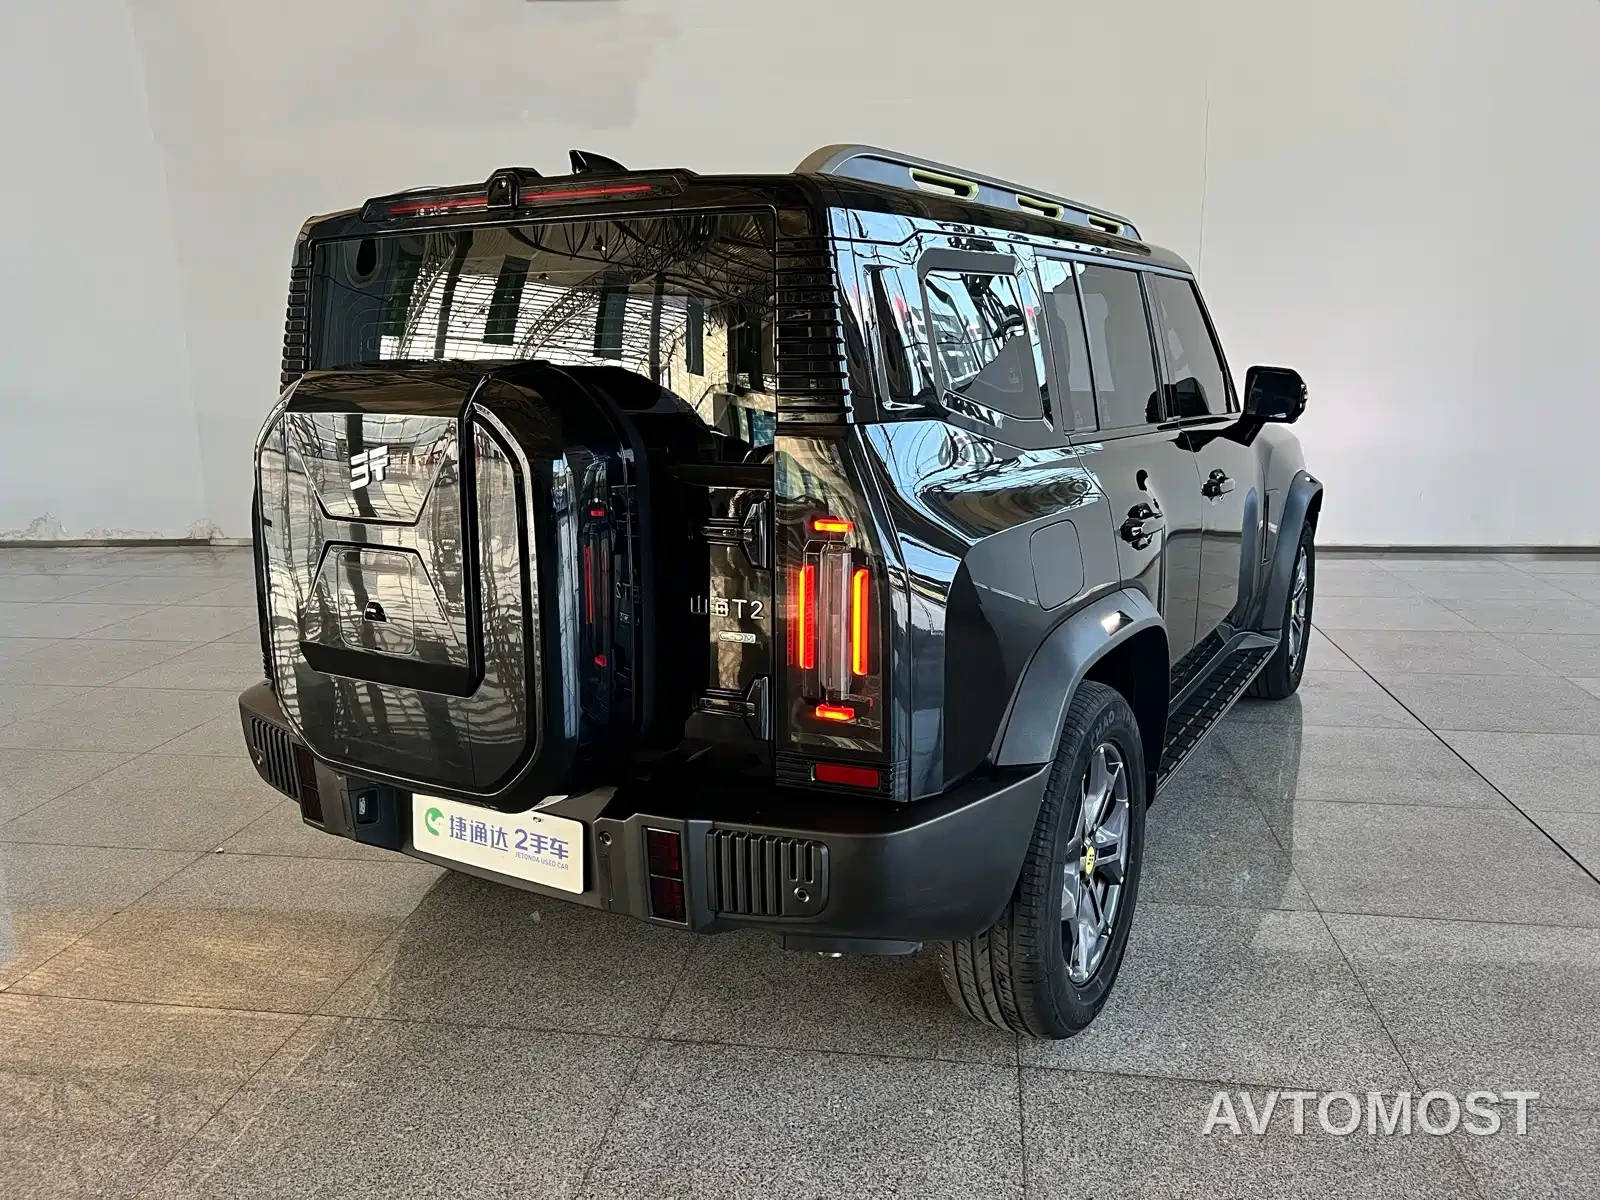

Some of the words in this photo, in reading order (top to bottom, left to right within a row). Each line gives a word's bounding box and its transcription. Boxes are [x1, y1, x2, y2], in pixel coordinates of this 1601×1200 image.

[449, 814, 508, 852] 捷通达
[514, 828, 569, 860] 2手车
[541, 858, 556, 867] USED
[557, 862, 569, 871] CAR
